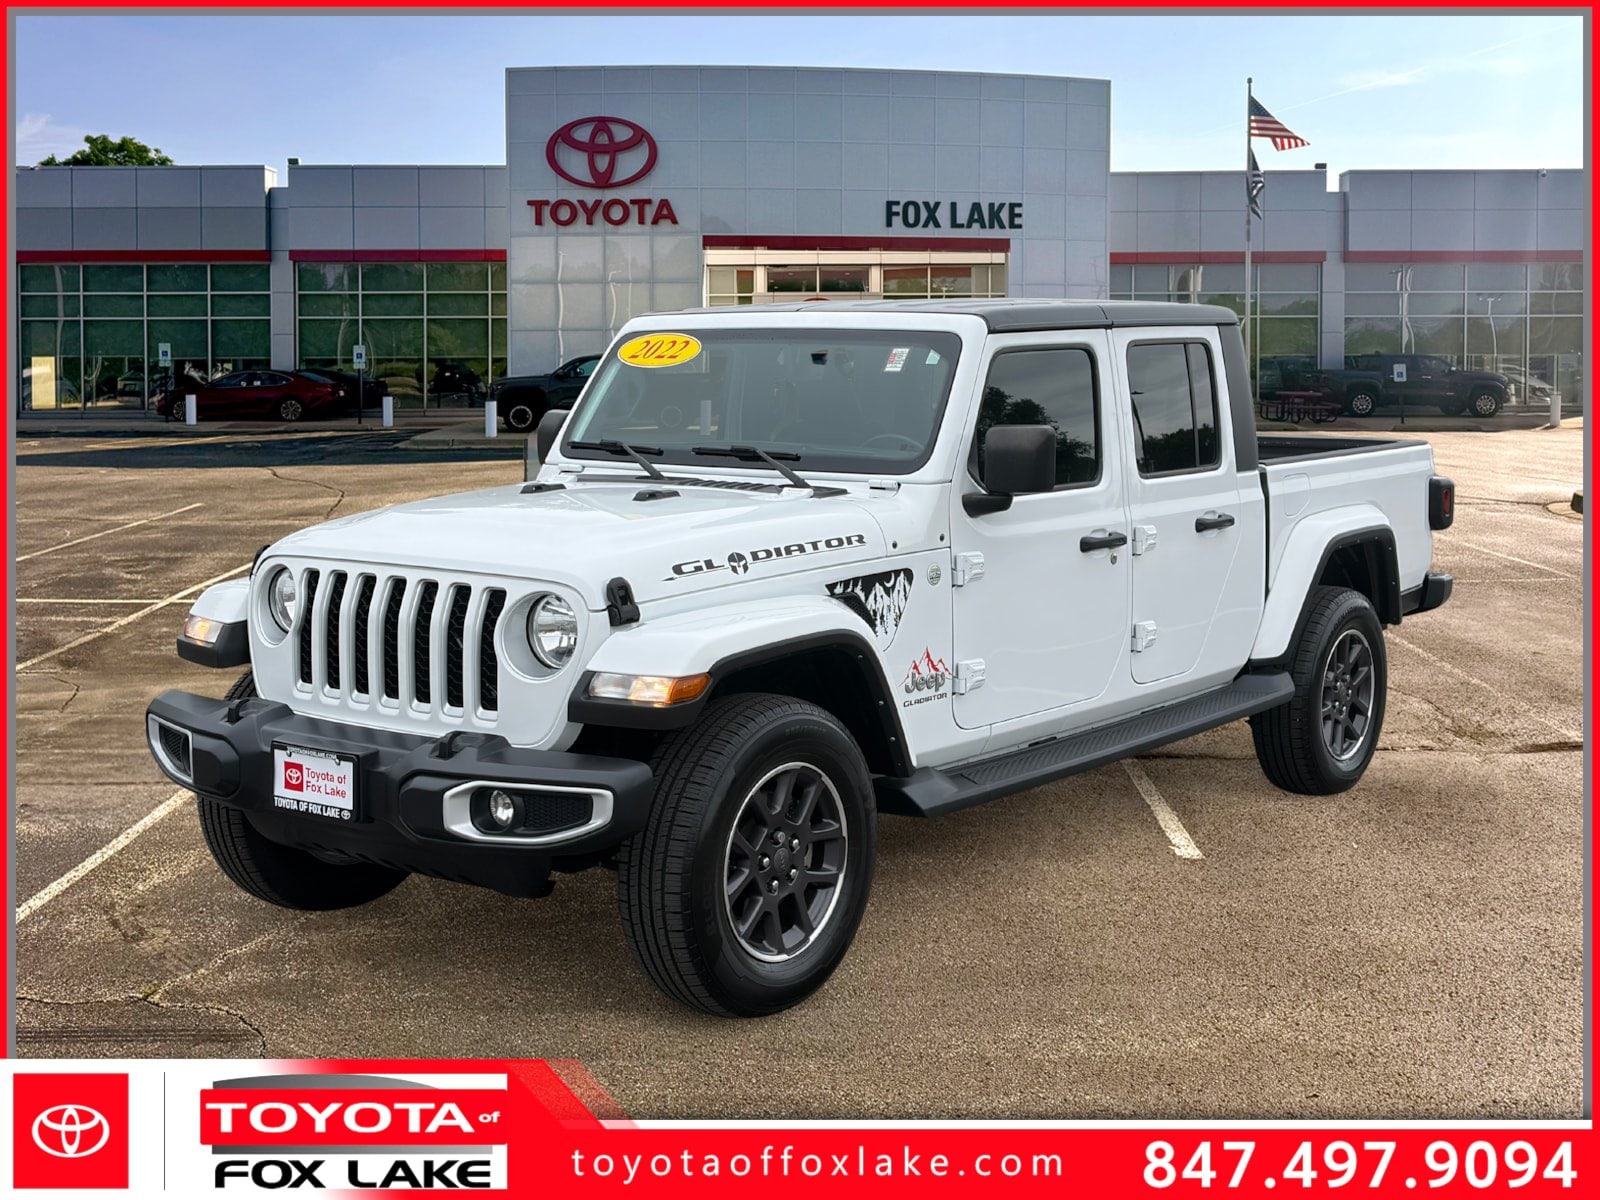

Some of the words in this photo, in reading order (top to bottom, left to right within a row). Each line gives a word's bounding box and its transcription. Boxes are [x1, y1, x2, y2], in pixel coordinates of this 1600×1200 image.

[527, 198, 679, 226] TOYOTA
[885, 200, 941, 229] FOX
[950, 201, 1023, 230] LAKE
[628, 340, 690, 359] 2022
[671, 533, 867, 576] GLDIATOR
[904, 671, 946, 694] Jeep
[903, 692, 948, 708] GLADIATOR
[305, 767, 335, 783] Toyota
[337, 774, 347, 785] of
[305, 780, 322, 794] Fox
[324, 785, 347, 799] Lake
[273, 796, 298, 811] TOYOTA
[299, 801, 308, 812] OF
[308, 803, 322, 815] FOX
[322, 806, 341, 819] LAKE
